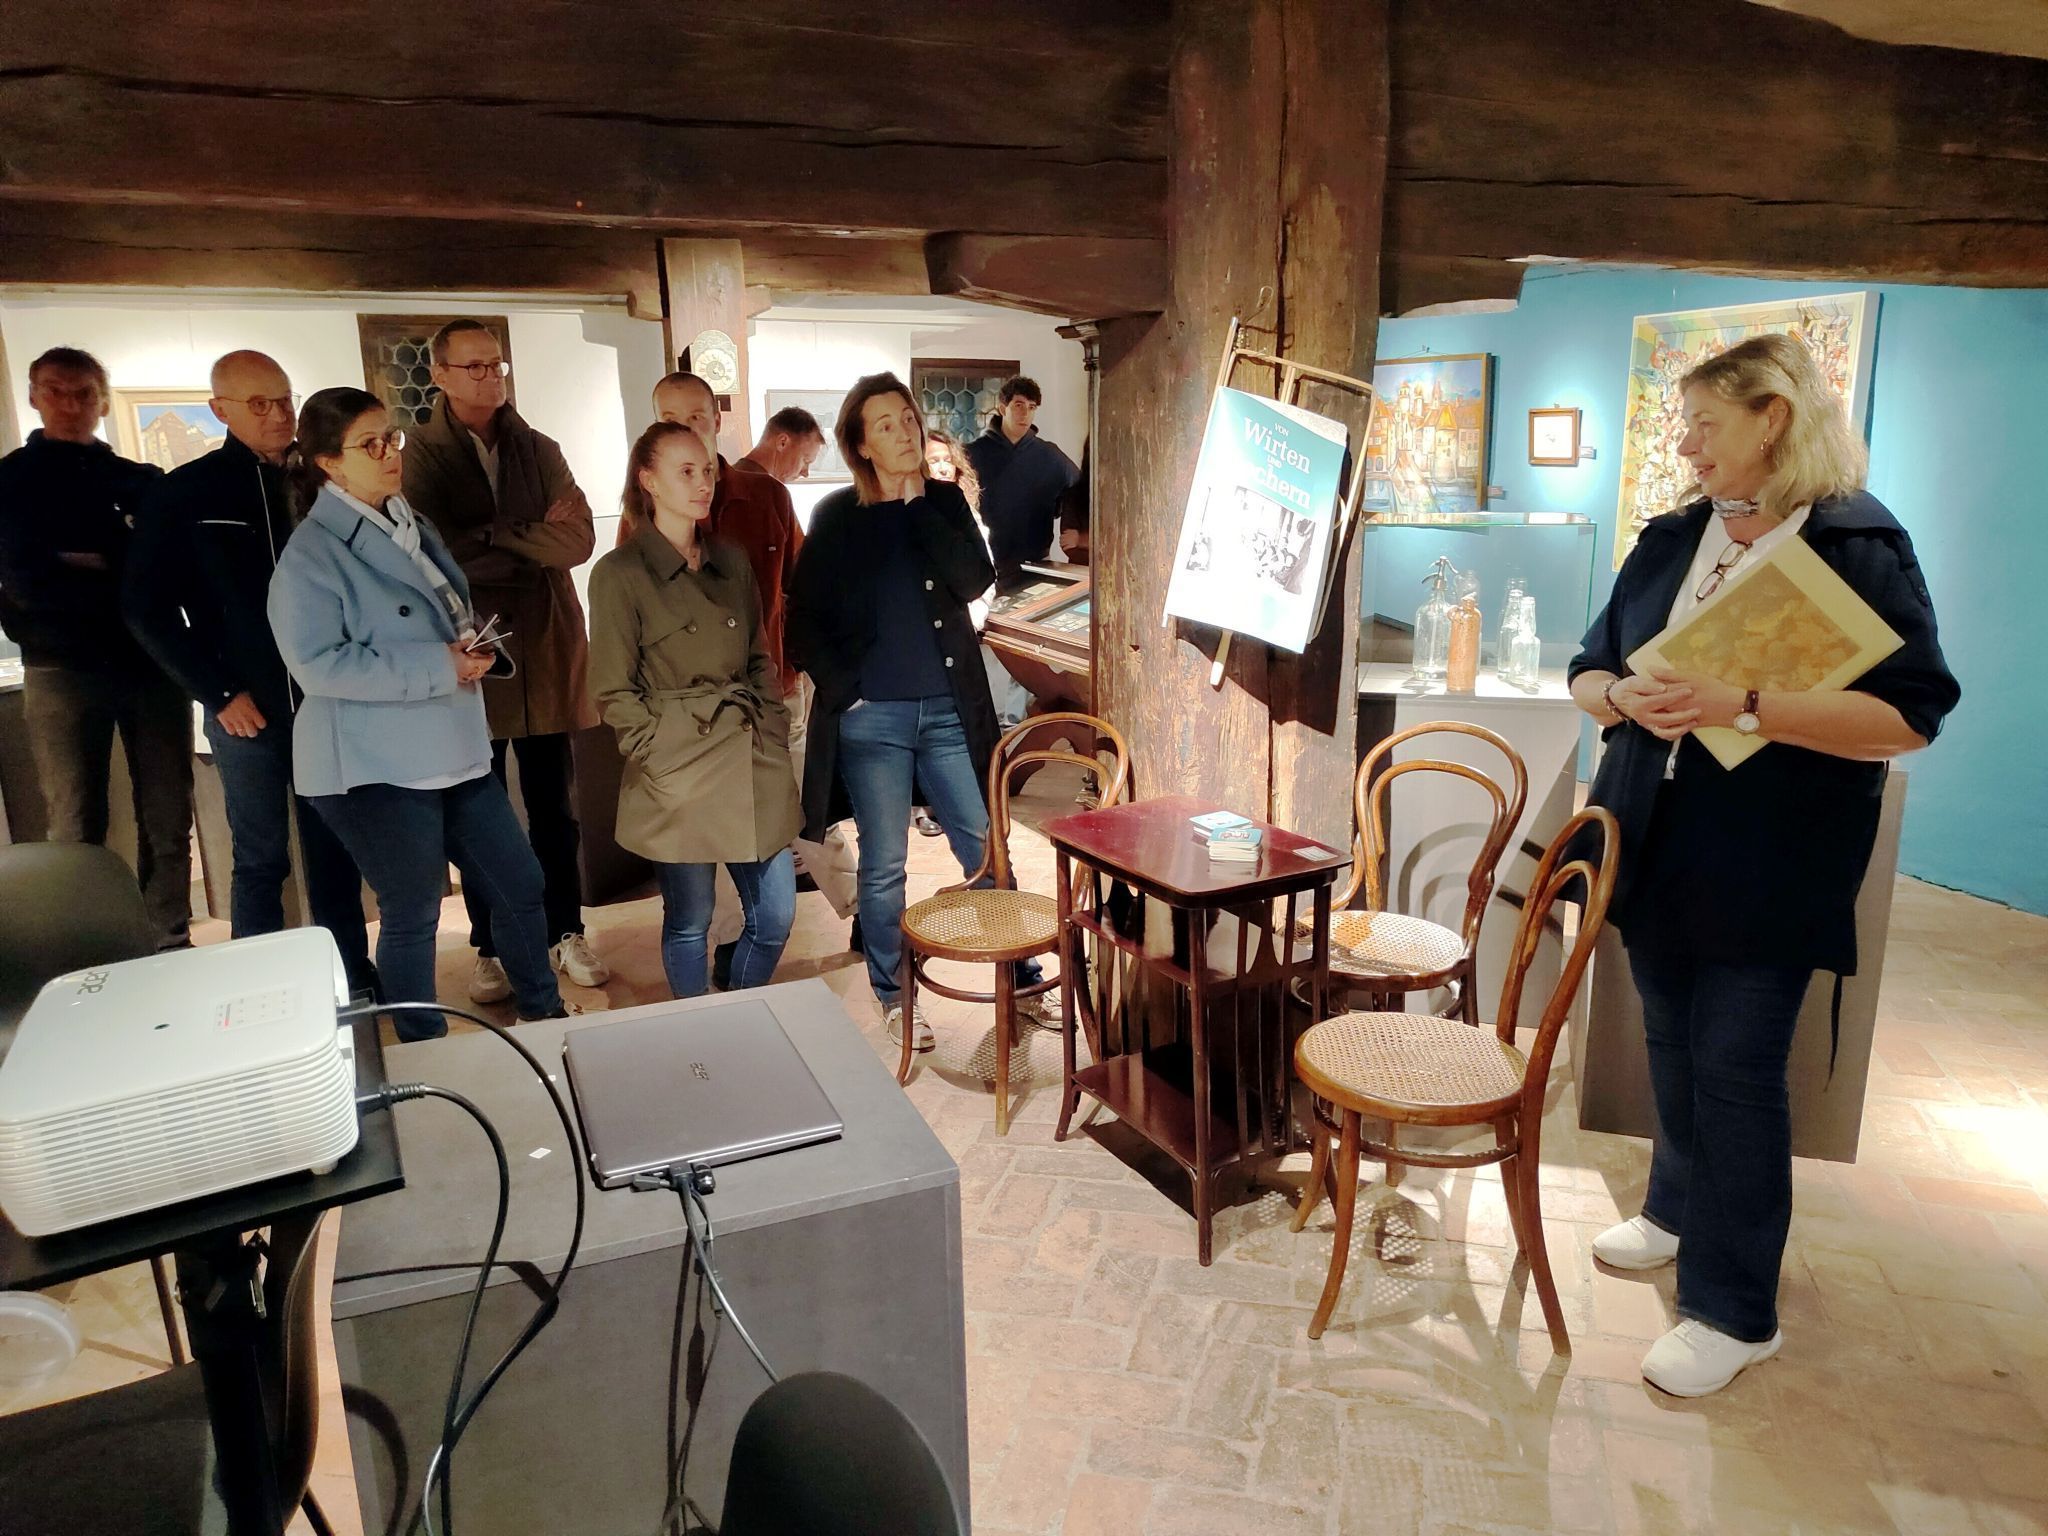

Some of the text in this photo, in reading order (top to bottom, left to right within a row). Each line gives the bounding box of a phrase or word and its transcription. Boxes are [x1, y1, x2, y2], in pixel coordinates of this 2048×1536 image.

[1243, 416, 1311, 474] Wirten
[1274, 423, 1289, 437] VON
[1250, 462, 1311, 510] chern
